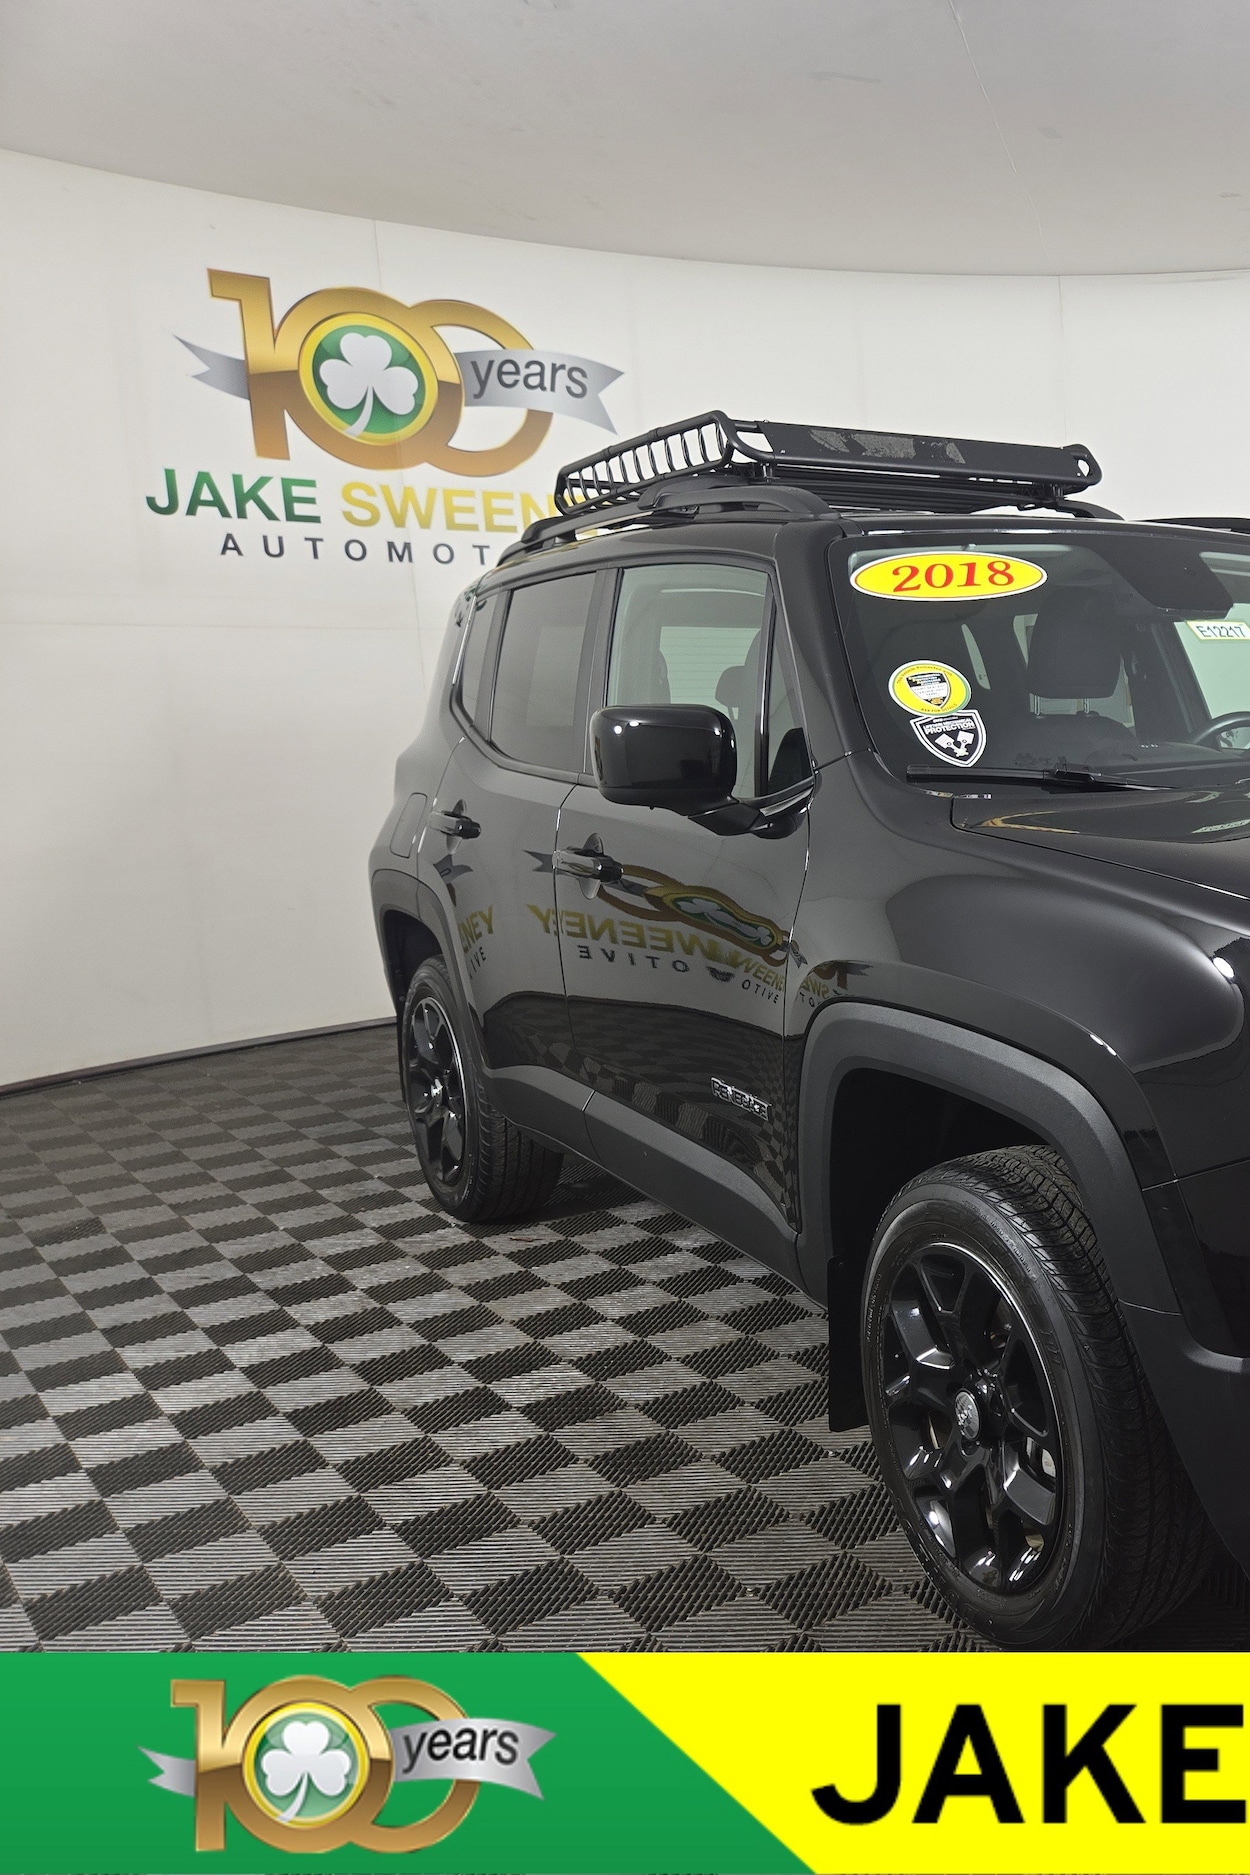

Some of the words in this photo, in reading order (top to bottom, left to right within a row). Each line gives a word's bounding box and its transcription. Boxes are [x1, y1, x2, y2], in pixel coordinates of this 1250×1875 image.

[207, 267, 554, 477] 100
[470, 357, 588, 399] years
[146, 468, 322, 524] JAKE
[341, 481, 600, 534] SWEEN
[892, 560, 1015, 593] 2018
[1195, 625, 1246, 638] E12217
[925, 720, 976, 735] PROTECTION
